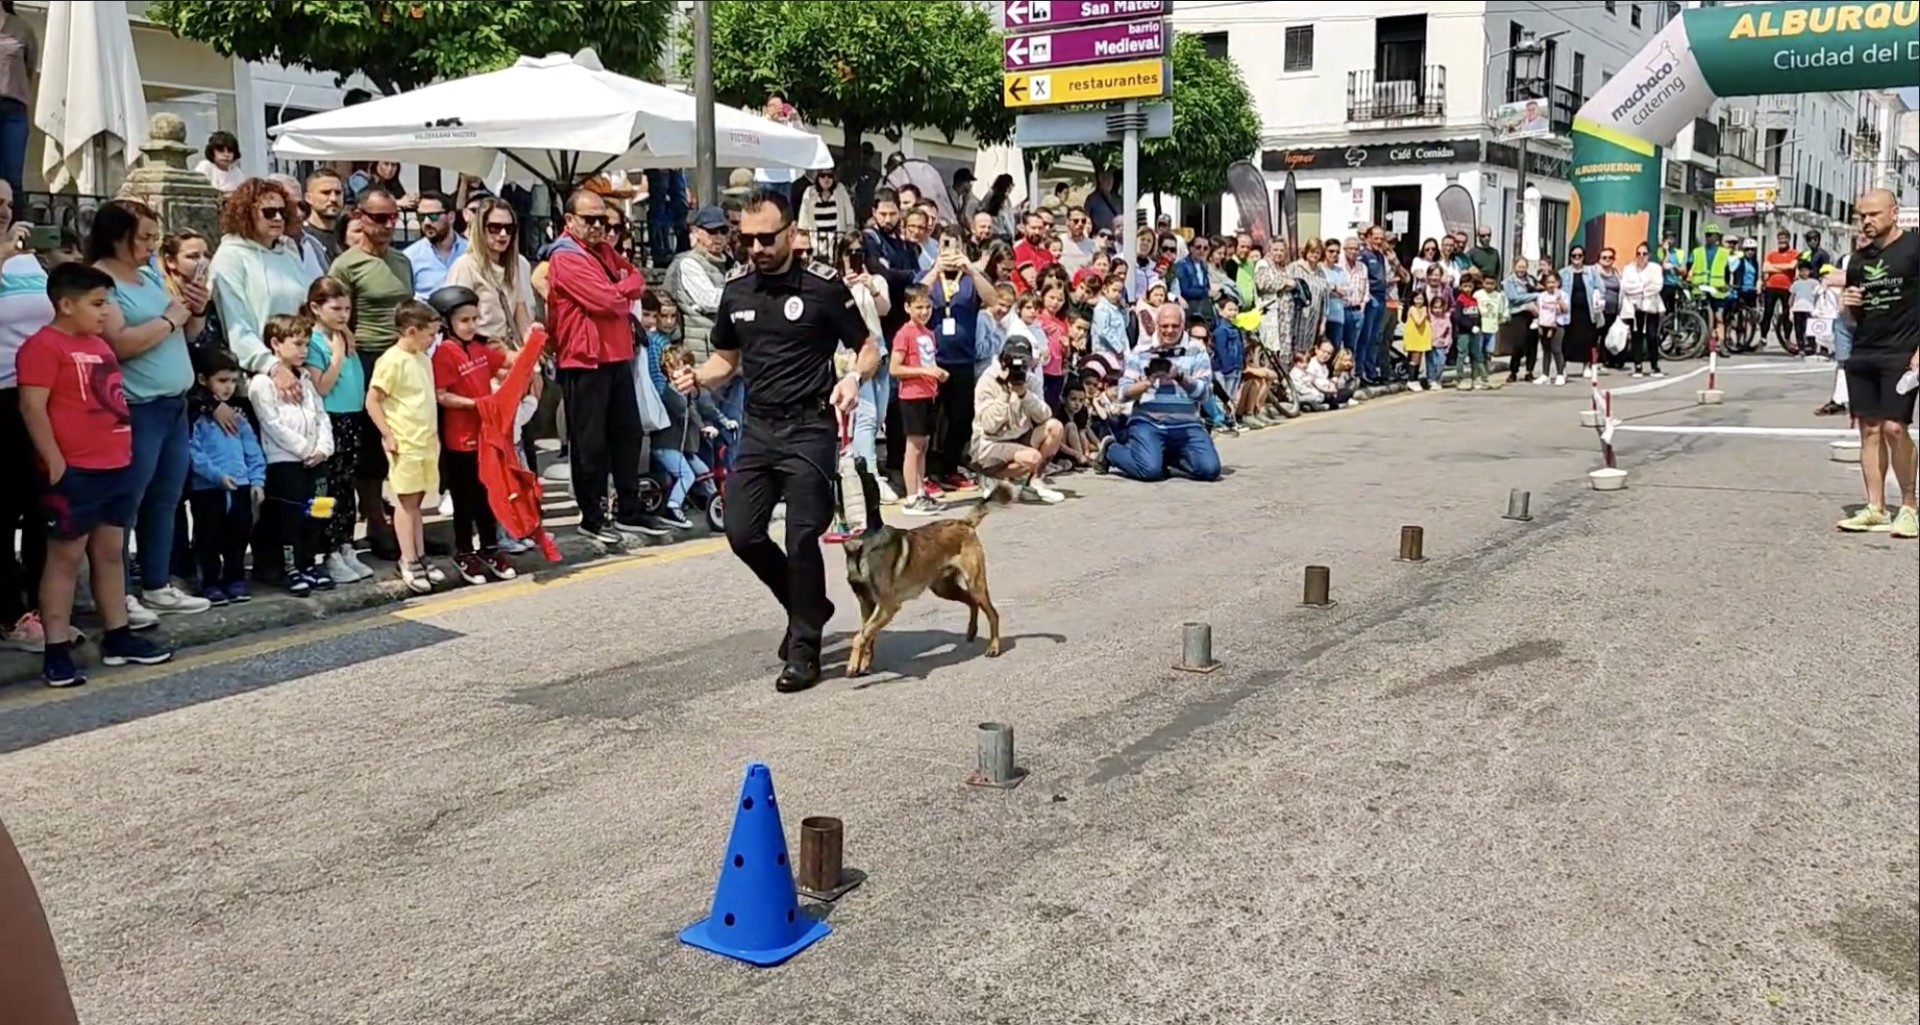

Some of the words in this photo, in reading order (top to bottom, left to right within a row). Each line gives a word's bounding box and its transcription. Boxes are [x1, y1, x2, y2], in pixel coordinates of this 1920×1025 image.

[1080, 2, 1110, 17] San
[1114, 1, 1160, 14] Mateo
[1128, 22, 1160, 34] barrio
[1728, 2, 1919, 39] ALBURQU
[1094, 35, 1160, 56] Medieval
[1773, 45, 1855, 70] Ciudad
[1862, 41, 1898, 64] del
[1069, 73, 1158, 91] restaurantes
[1611, 62, 1673, 123] machaco
[1632, 76, 1687, 126] catering
[1389, 148, 1412, 161] Café
[1415, 147, 1455, 159] Comidas
